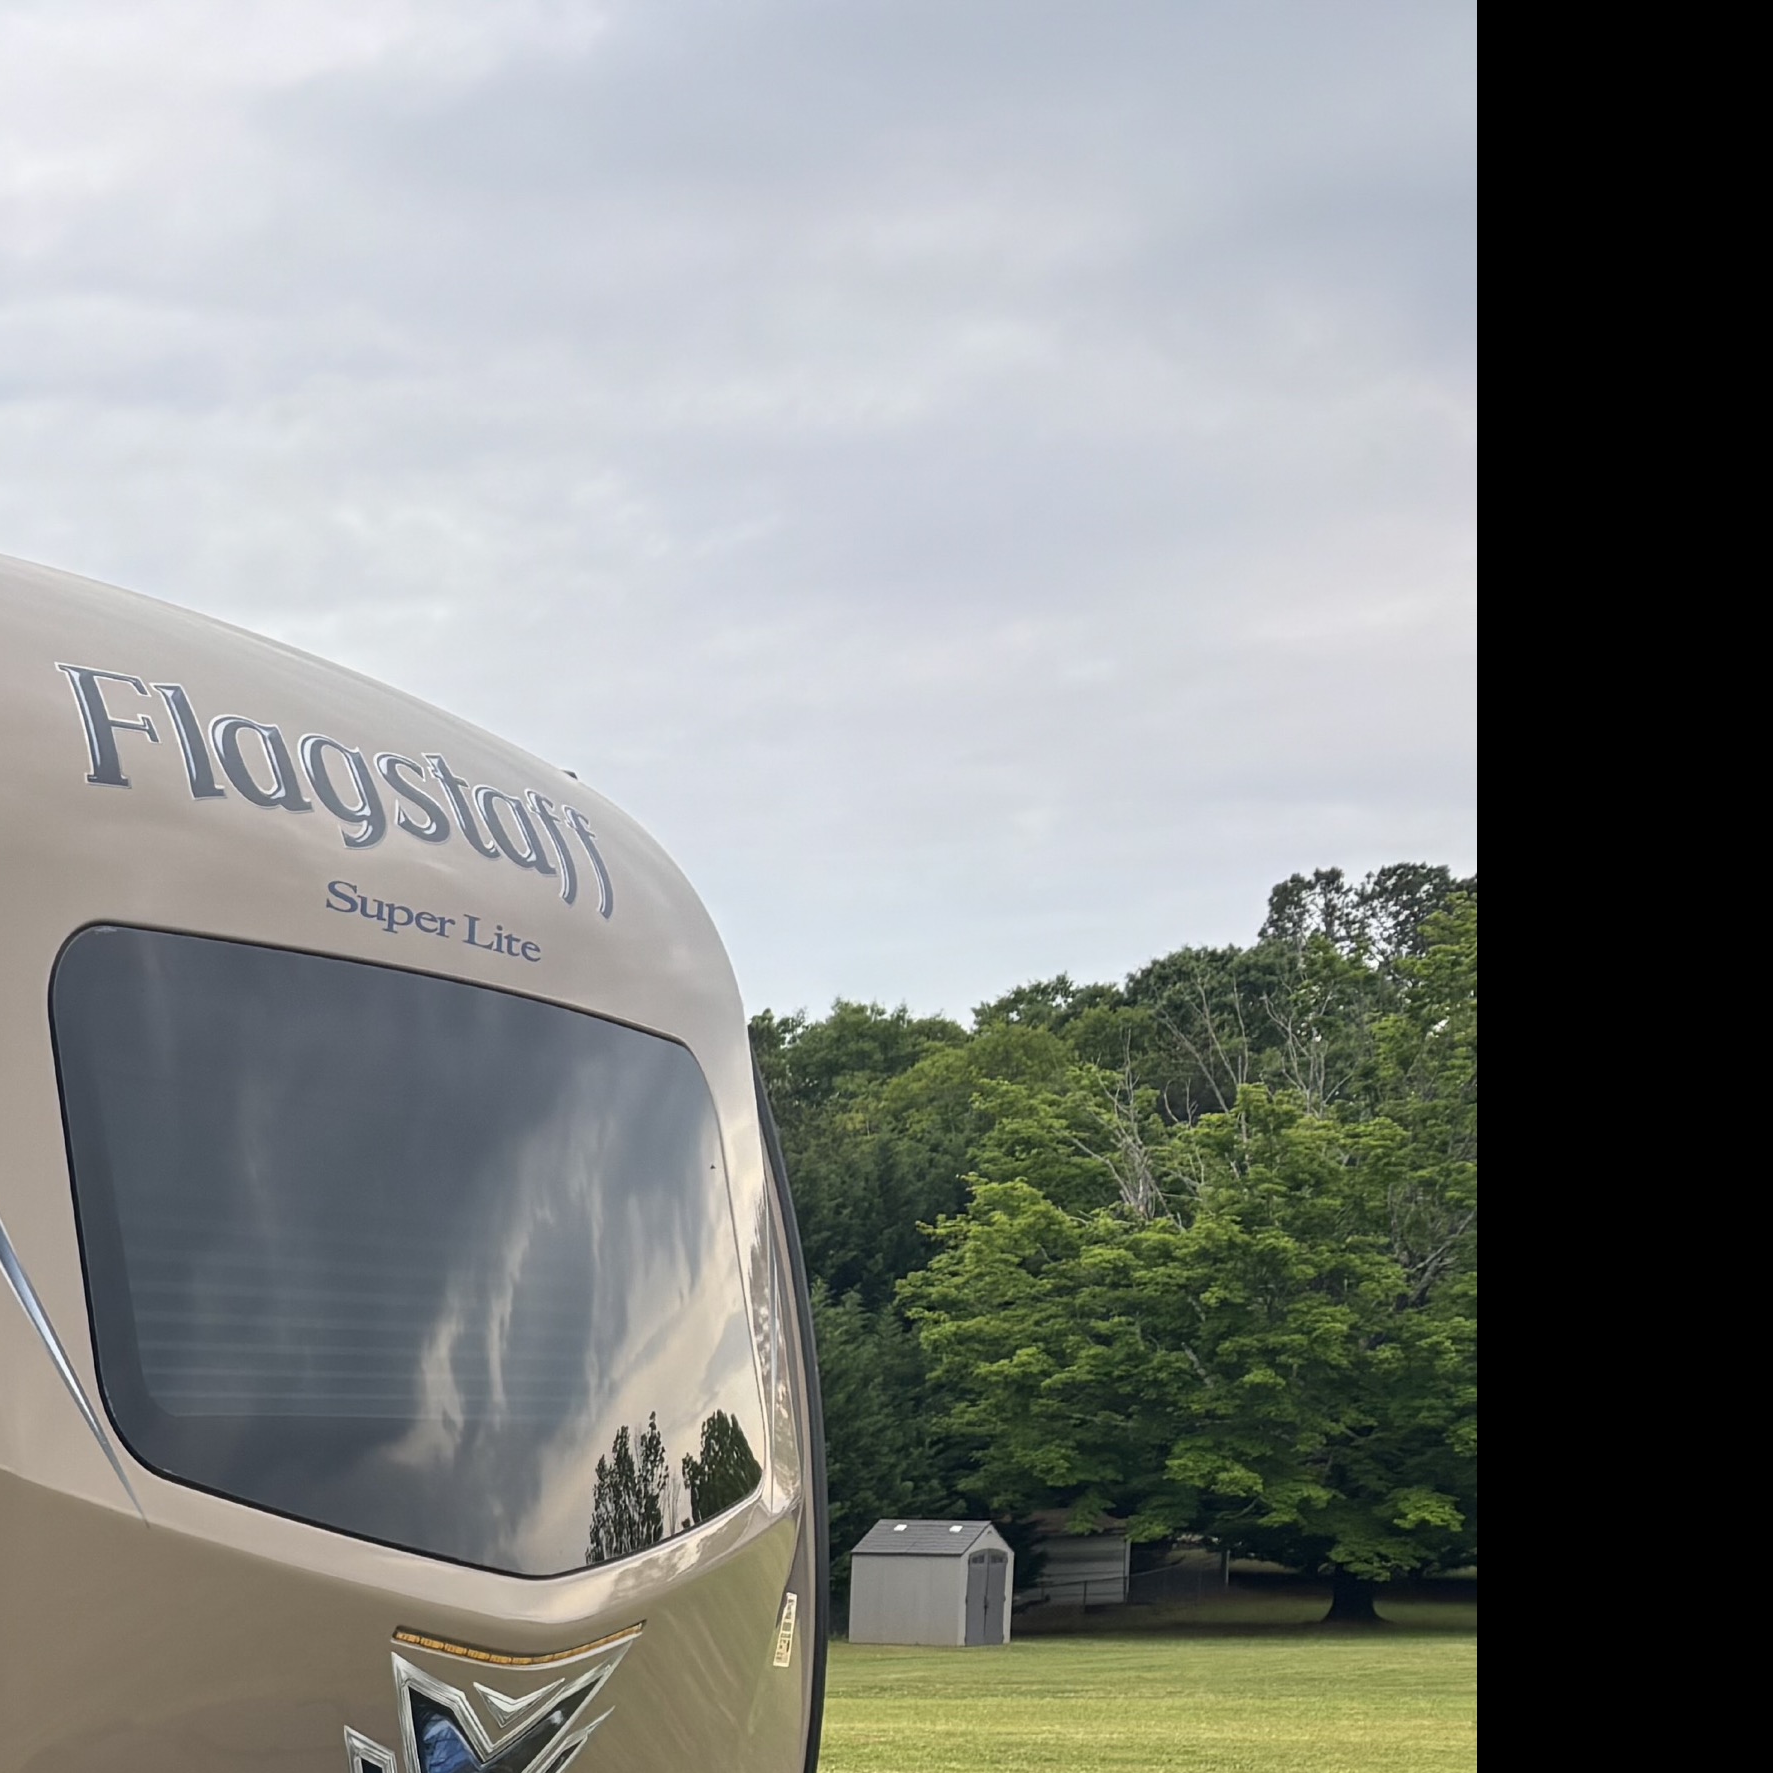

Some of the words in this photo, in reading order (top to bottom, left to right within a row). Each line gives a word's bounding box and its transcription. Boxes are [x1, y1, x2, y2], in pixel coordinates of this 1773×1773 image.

[55, 661, 613, 919] Flagstaff
[325, 880, 456, 938] Super
[463, 914, 542, 963] Lite
